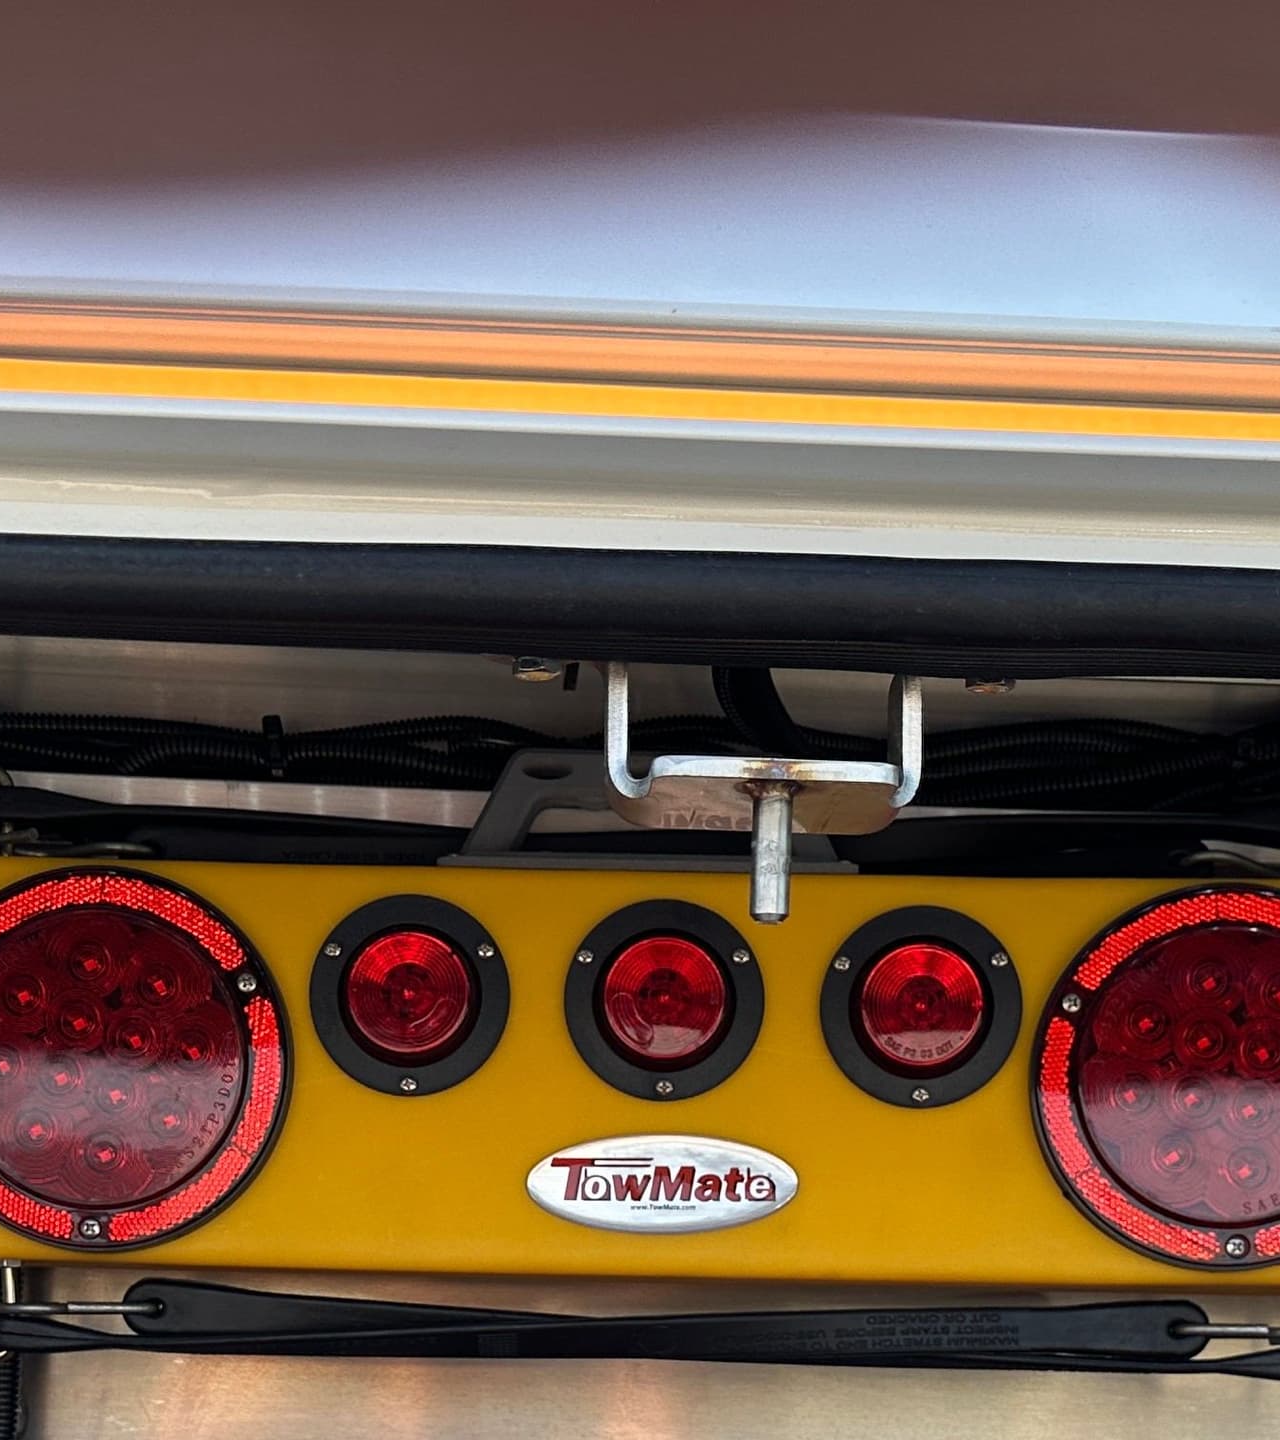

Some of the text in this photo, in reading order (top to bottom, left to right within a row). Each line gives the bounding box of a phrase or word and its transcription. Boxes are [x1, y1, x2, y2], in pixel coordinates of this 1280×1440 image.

[550, 1157, 777, 1202] TowMate
[865, 1314, 940, 1326] CRACKED
[970, 1313, 1002, 1324] CUT
[872, 1338, 944, 1348] STRETCH
